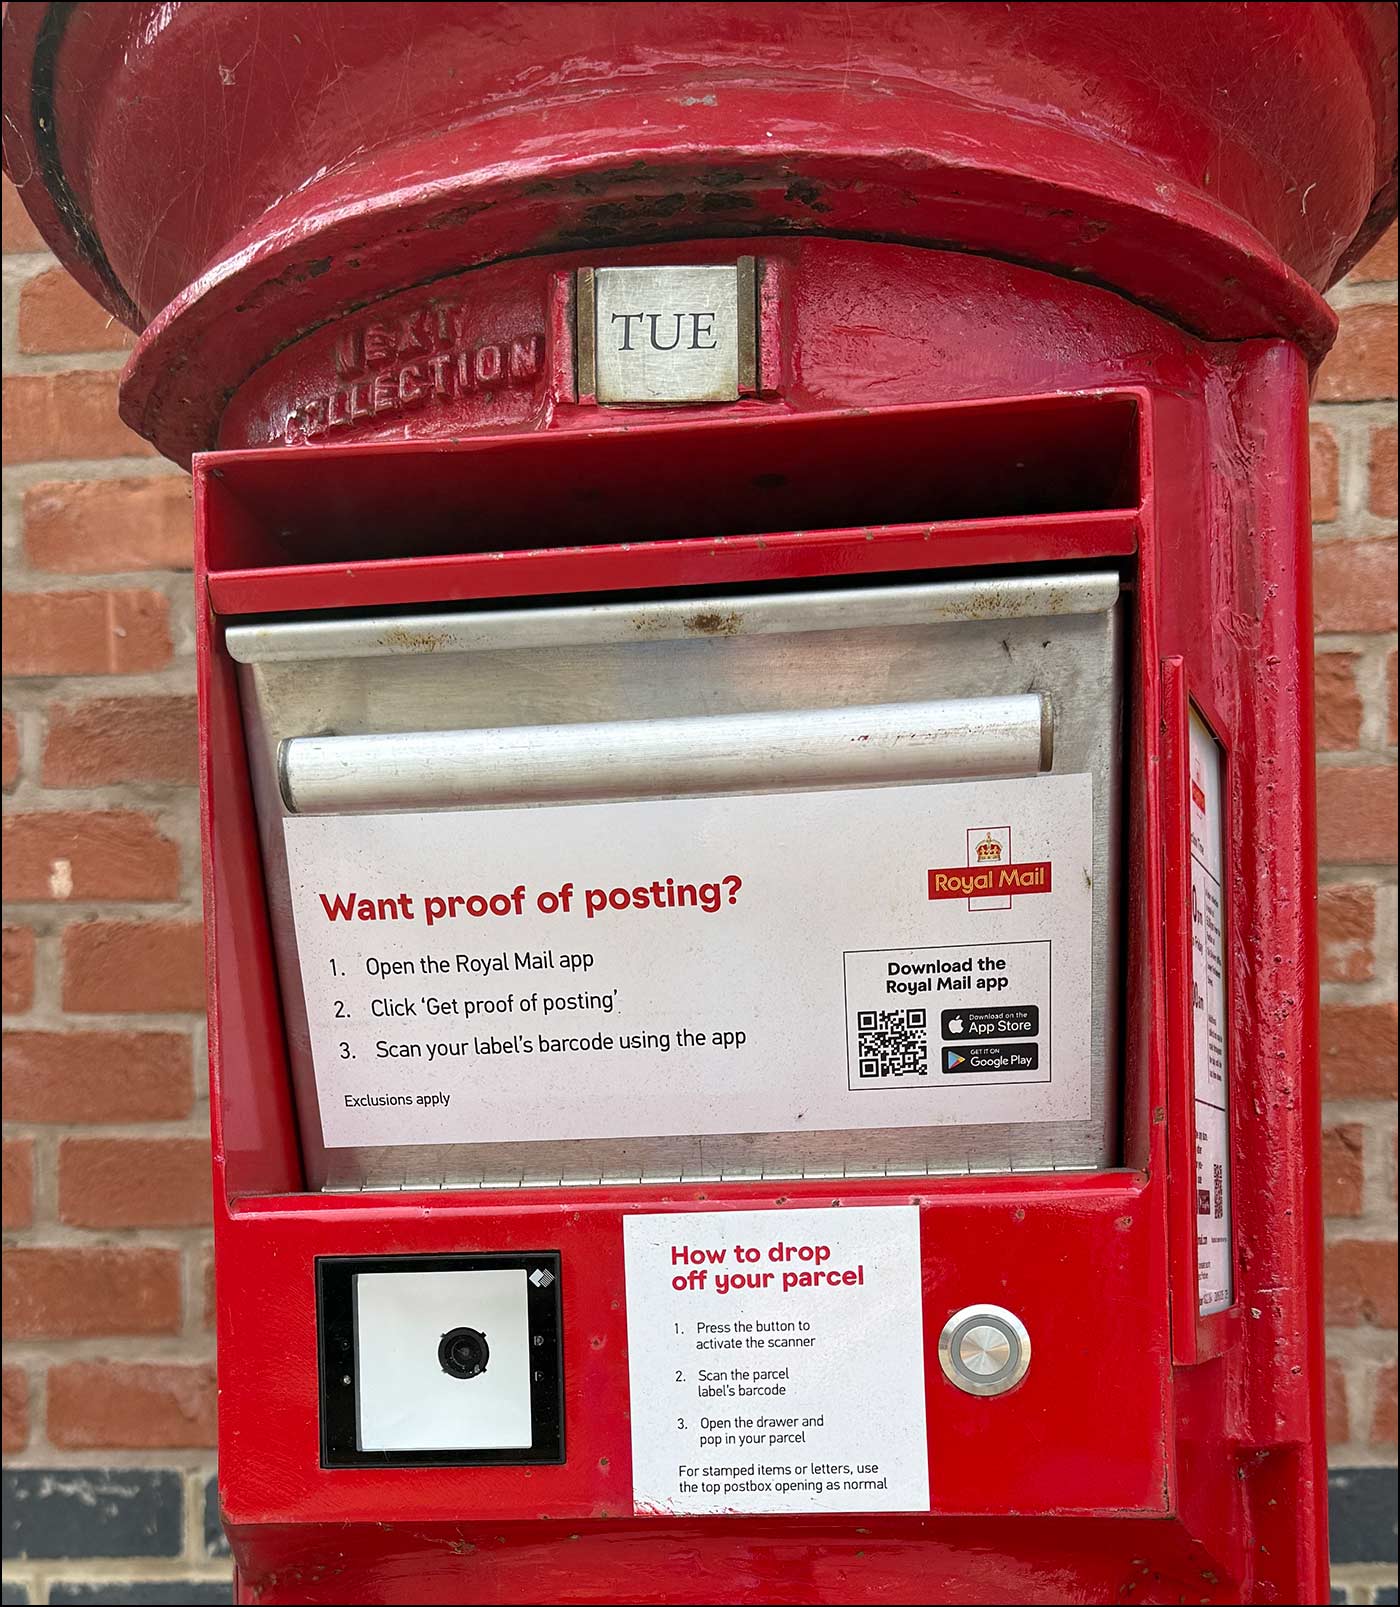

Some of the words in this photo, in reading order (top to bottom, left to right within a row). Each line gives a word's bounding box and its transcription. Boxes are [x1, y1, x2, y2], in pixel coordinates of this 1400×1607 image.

[334, 298, 463, 376] NEXT
[611, 312, 718, 351] TUE
[284, 336, 539, 445] COLLECTION
[935, 871, 993, 894] Royal
[998, 867, 1045, 887] Mail
[319, 891, 414, 922] Want
[424, 885, 527, 926] proof
[537, 883, 573, 914] of
[585, 874, 744, 917] posting?
[328, 958, 346, 978] 1.
[365, 956, 415, 978] Open
[419, 956, 451, 974] the
[456, 953, 510, 975] Royal
[514, 951, 555, 971] Mail
[559, 952, 595, 972] app
[887, 957, 973, 976] Download
[977, 957, 1007, 971] the
[886, 978, 932, 995] Royal
[936, 976, 972, 991] Mail
[976, 975, 1009, 990] app
[334, 1000, 352, 1019] 2.
[370, 997, 417, 1018] Click
[420, 995, 459, 1017] ‘Get
[464, 994, 515, 1017] proof
[518, 993, 538, 1013] of
[542, 989, 618, 1013] posting’
[969, 1021, 995, 1034] App
[997, 1020, 1032, 1031] Store
[339, 1042, 356, 1060] 3.
[375, 1040, 422, 1059] Scan
[425, 1040, 470, 1060] your
[473, 1034, 534, 1055] label’s
[538, 1033, 614, 1054] barcode
[618, 1032, 671, 1052] using
[675, 1029, 707, 1047] the
[711, 1029, 746, 1049] app
[970, 1057, 1009, 1069] Google
[1010, 1054, 1032, 1067] Play
[344, 1094, 413, 1108] Exclusions
[416, 1093, 451, 1108] apply
[671, 1246, 726, 1265] How
[734, 1246, 760, 1263] to
[768, 1242, 830, 1265] drop
[672, 1270, 707, 1290] off
[715, 1271, 774, 1294] your
[782, 1266, 864, 1292] parcel
[674, 1323, 684, 1334] 1.
[697, 1322, 731, 1334] Press
[734, 1322, 752, 1333] the
[756, 1321, 795, 1332] button
[798, 1321, 810, 1331] to
[696, 1338, 742, 1350] activate
[746, 1338, 764, 1348] the
[768, 1337, 816, 1348] scanner
[675, 1371, 686, 1382] 2.
[698, 1370, 728, 1381] Scan
[731, 1369, 750, 1380] the
[753, 1368, 789, 1382] parcel
[698, 1385, 736, 1397] label’s
[738, 1384, 786, 1396] barcode
[678, 1419, 688, 1430] 3.
[700, 1418, 731, 1431] Open
[734, 1417, 753, 1428] the
[756, 1416, 799, 1427] drawer
[802, 1415, 824, 1426] and
[700, 1434, 722, 1447] pop
[725, 1433, 736, 1444] in
[739, 1434, 766, 1446] your
[769, 1432, 806, 1446] parcel
[679, 1466, 699, 1476] For
[702, 1464, 755, 1478] stamped
[758, 1464, 792, 1475] items
[794, 1466, 808, 1474] or
[811, 1463, 853, 1476] letters,
[856, 1464, 878, 1474] use
[680, 1482, 698, 1493] the
[702, 1482, 720, 1494] top
[724, 1480, 772, 1494] postbox
[775, 1480, 822, 1493] opening
[826, 1480, 840, 1490] as
[844, 1478, 888, 1490] normal
